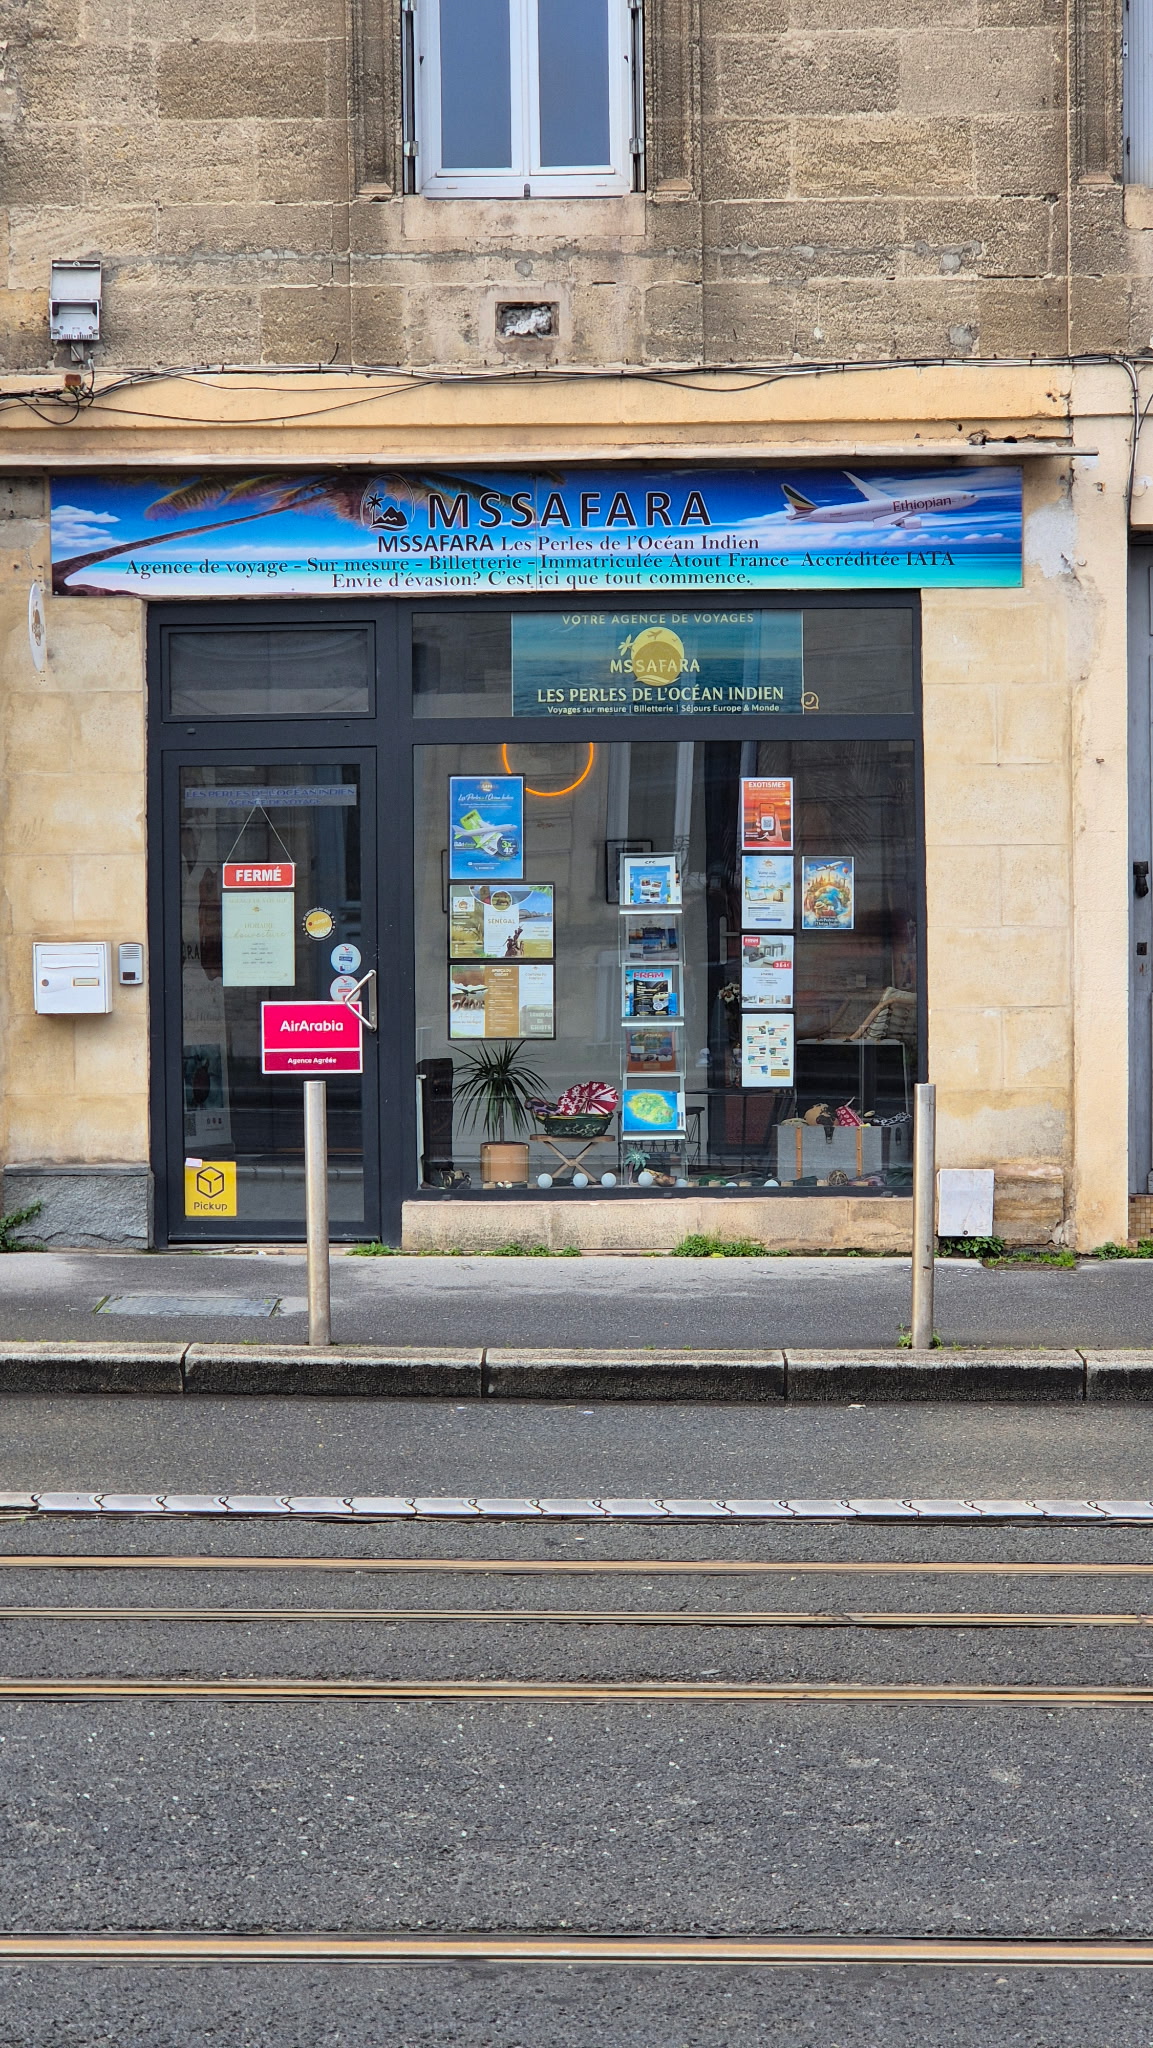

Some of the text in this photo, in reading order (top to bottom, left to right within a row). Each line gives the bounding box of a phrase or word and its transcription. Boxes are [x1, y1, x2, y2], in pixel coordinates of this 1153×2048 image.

[427, 491, 713, 529] MSSAFARA
[892, 496, 952, 512] Ethiopian
[378, 534, 759, 553] MSSAFARA Les Perles de l'Océan Indien
[125, 559, 193, 579] Agence
[199, 559, 220, 574] de
[225, 561, 288, 578] voyage
[307, 557, 338, 572] Sur
[344, 559, 409, 571] mesure
[429, 554, 522, 570] Billetterie
[540, 553, 663, 568] Immatriculée
[669, 552, 721, 567] Atout
[728, 552, 789, 567] France
[801, 551, 900, 567] Accréditée
[906, 551, 955, 566] IATA
[332, 570, 751, 589] Envie d'évasion? C'est ici que tout commence.
[562, 613, 754, 625] VOTRE AGENCE DE VOYAGES
[537, 683, 784, 703] LES PERLES DE L'OCÉAN INDIEN
[547, 706, 581, 715] Voyages
[633, 704, 674, 713] Billetterie
[681, 703, 711, 713] Séjours
[713, 704, 742, 713] Europe
[743, 704, 750, 712] &
[751, 704, 780, 712] Monde
[235, 866, 282, 882] FERMÉ
[633, 971, 665, 979] FRAM
[279, 1019, 344, 1032] AirArabia
[287, 1056, 337, 1065] Agence Agréée
[193, 1201, 228, 1212] Pickup
